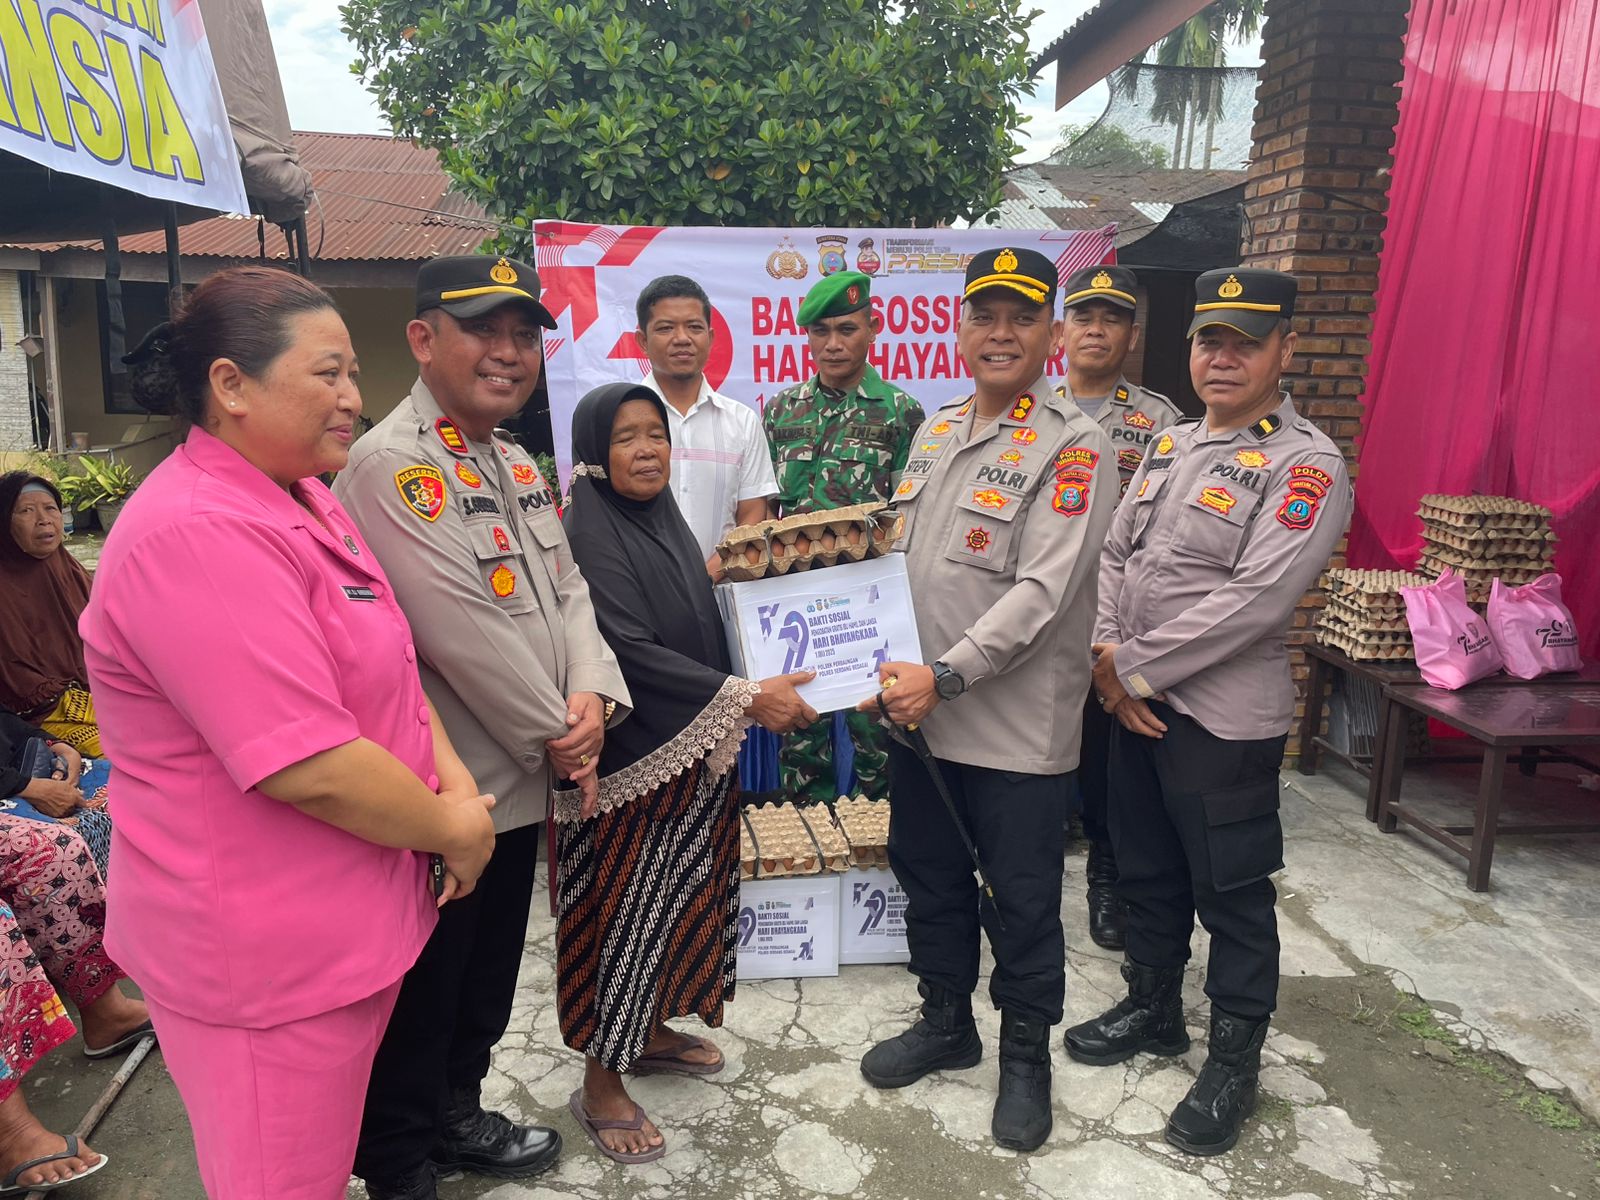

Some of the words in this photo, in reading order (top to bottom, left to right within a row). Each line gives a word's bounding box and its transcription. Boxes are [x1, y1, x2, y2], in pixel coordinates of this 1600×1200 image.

[751, 297, 809, 336] BA
[753, 344, 821, 383] HAR
[1112, 428, 1154, 445] POLR
[1059, 450, 1091, 459] POLRES
[976, 466, 1029, 489] POLRI
[1210, 462, 1261, 489] POLRI
[1294, 467, 1329, 483] POLDA
[808, 614, 828, 627] BAKTI
[828, 610, 851, 623] SOSIAL
[812, 637, 829, 649] HARI
[829, 626, 879, 646] BHAYANGKARA
